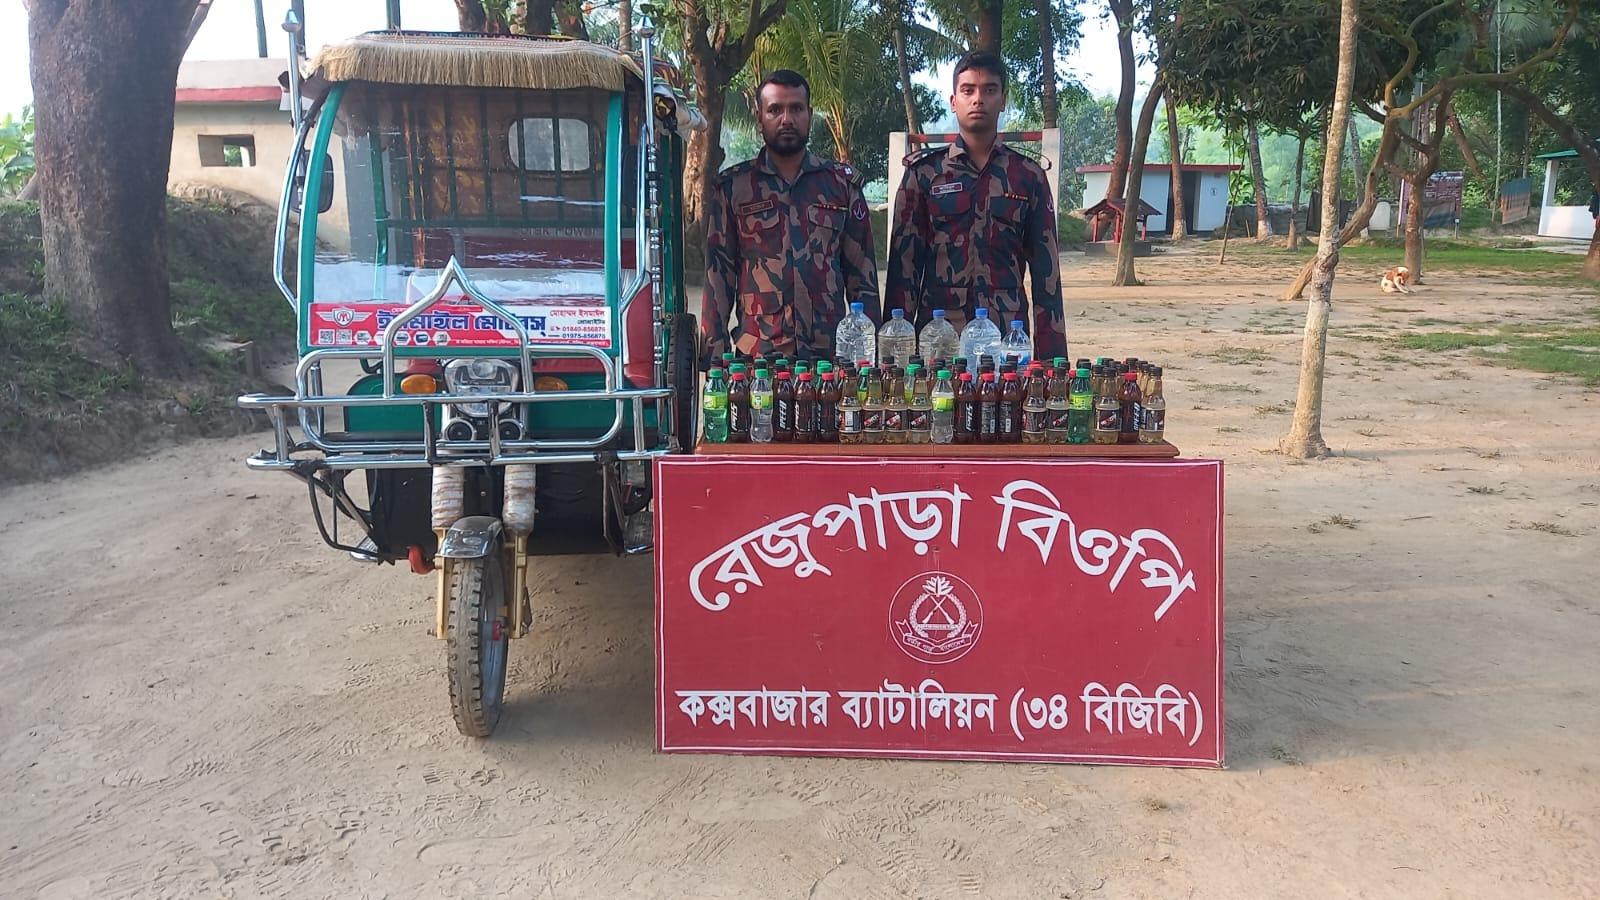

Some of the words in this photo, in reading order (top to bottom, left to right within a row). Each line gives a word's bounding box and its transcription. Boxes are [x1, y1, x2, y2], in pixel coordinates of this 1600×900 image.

[689, 483, 972, 611] রেজুপাড়া
[992, 479, 1197, 622] বিওপি
[675, 684, 831, 729] কক্সবাজার
[838, 679, 998, 733] ব্যাটালিয়ন
[1009, 687, 1069, 743] (৩৪
[1080, 681, 1204, 746] বিজিবি)
